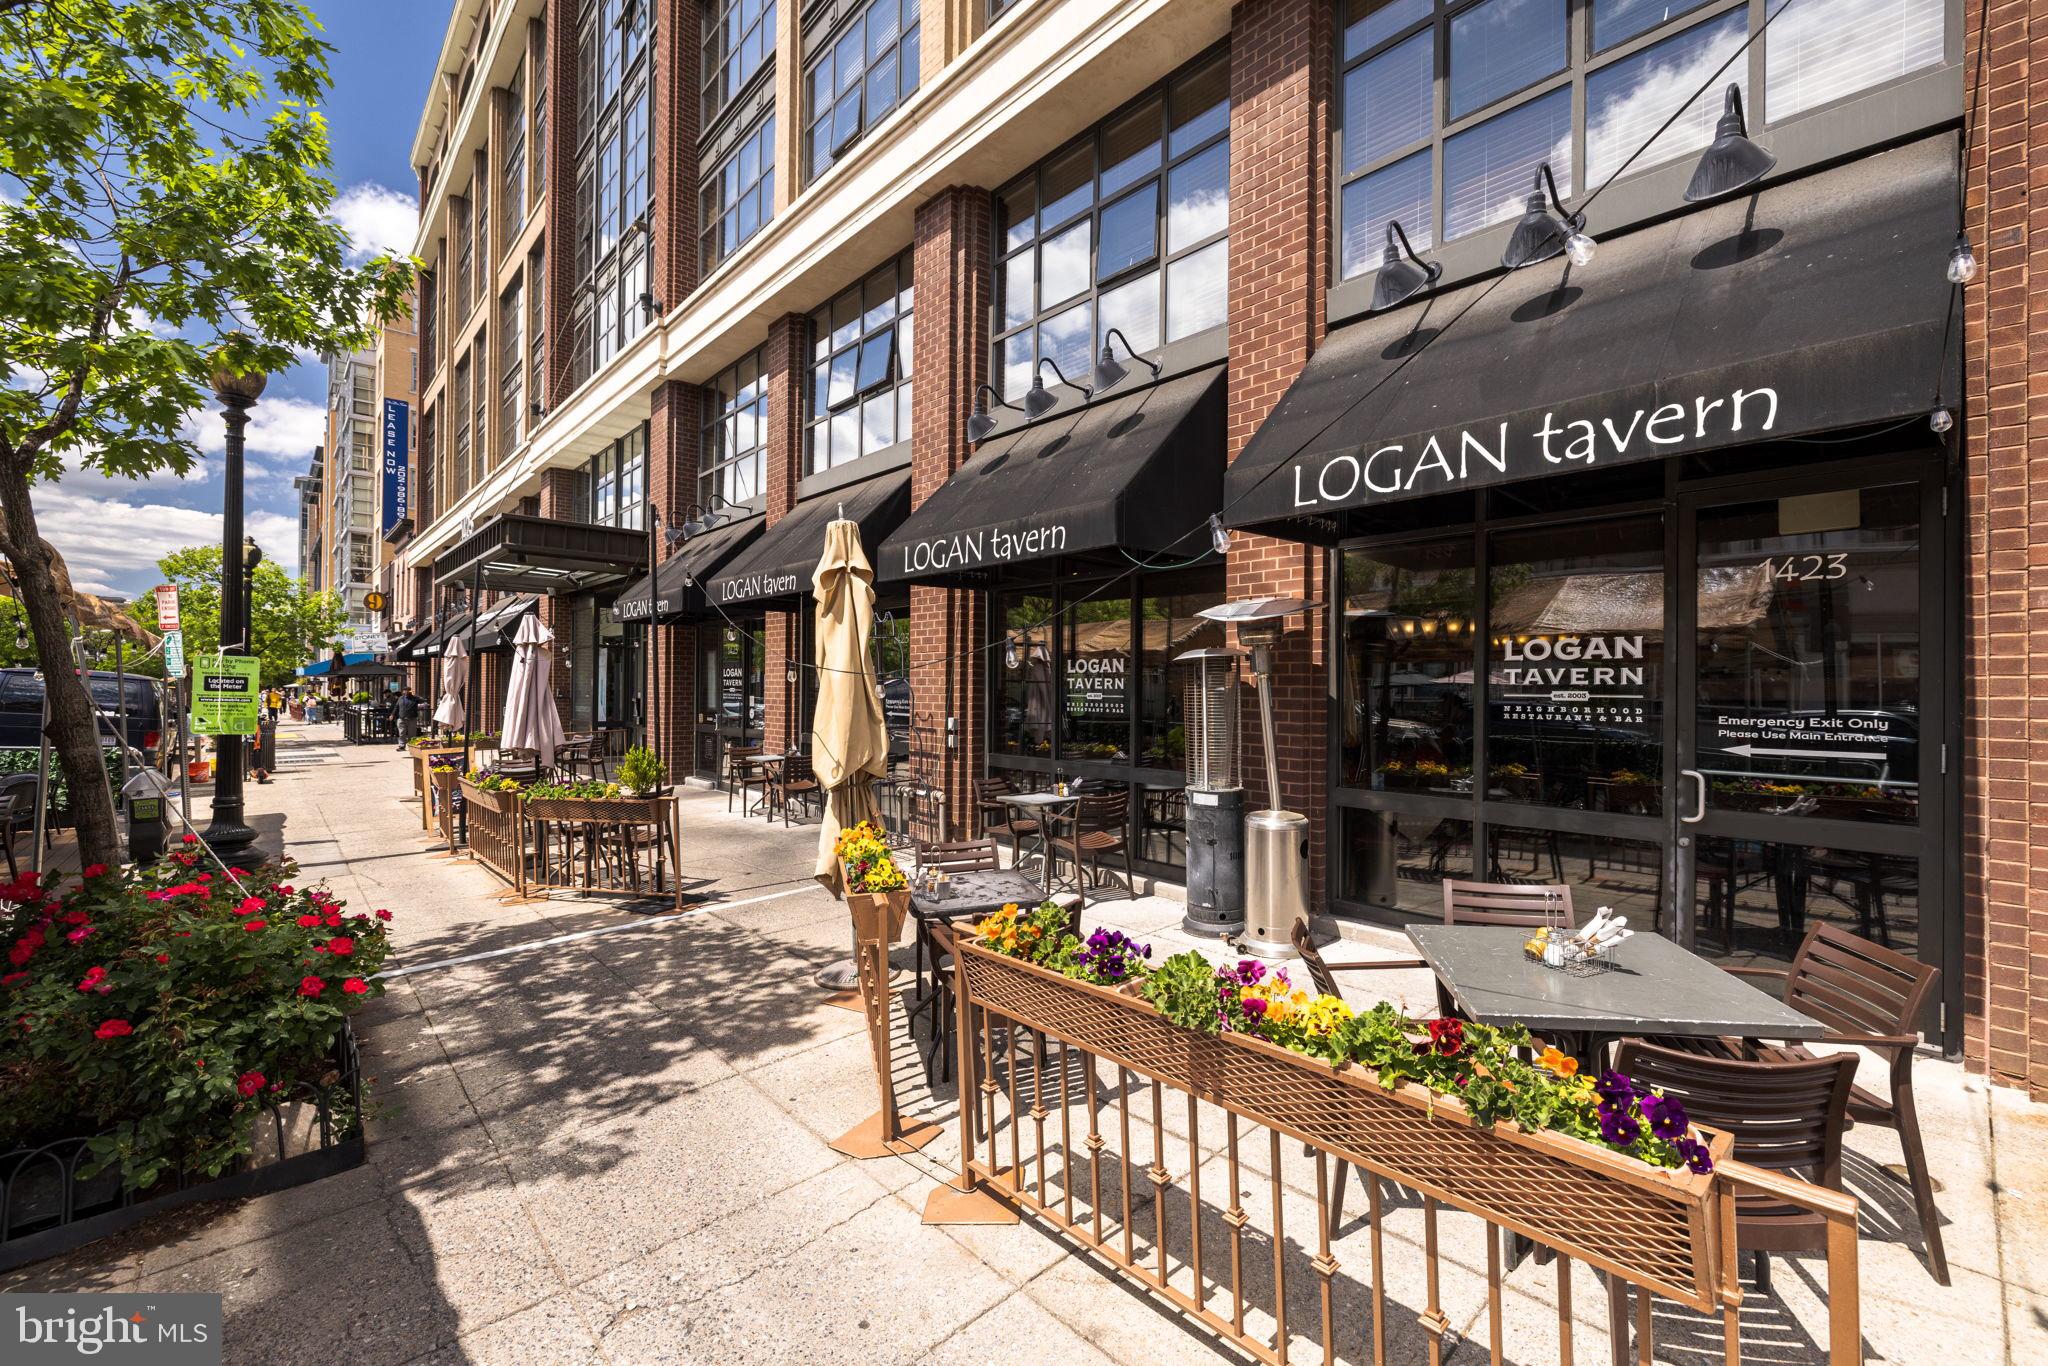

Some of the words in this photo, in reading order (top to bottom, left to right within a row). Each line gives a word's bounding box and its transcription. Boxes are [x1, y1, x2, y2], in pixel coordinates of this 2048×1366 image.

[387, 404, 396, 447] LEASE
[1294, 421, 1509, 507] LOGAN
[1533, 387, 1779, 464] tavern
[385, 450, 396, 475] NOW
[904, 531, 984, 573] LOGAN
[990, 525, 1066, 560] tavern
[1758, 552, 1848, 583] 1423
[722, 575, 761, 601] LOGAN
[763, 574, 796, 595] tavern
[623, 599, 648, 619] LOGAN
[648, 599, 669, 613] tern
[1504, 635, 1644, 661] LOGAN
[723, 668, 742, 677] LOGAN
[1067, 658, 1124, 674] LOGAN
[723, 679, 742, 687] TAVERN
[1067, 678, 1124, 690] TAVERN
[1503, 667, 1644, 686] TAVERN
[1503, 705, 1643, 715] NEIGHBORHOOD
[1503, 713, 1592, 722] RESTAURANT
[1718, 715, 1805, 729] Emergency
[1809, 717, 1843, 728] Exit
[1848, 718, 1889, 731] Only
[1718, 729, 1759, 739] Please
[1762, 731, 1786, 740] Use
[1789, 731, 1827, 741] Main
[1830, 732, 1889, 743] Entrance
